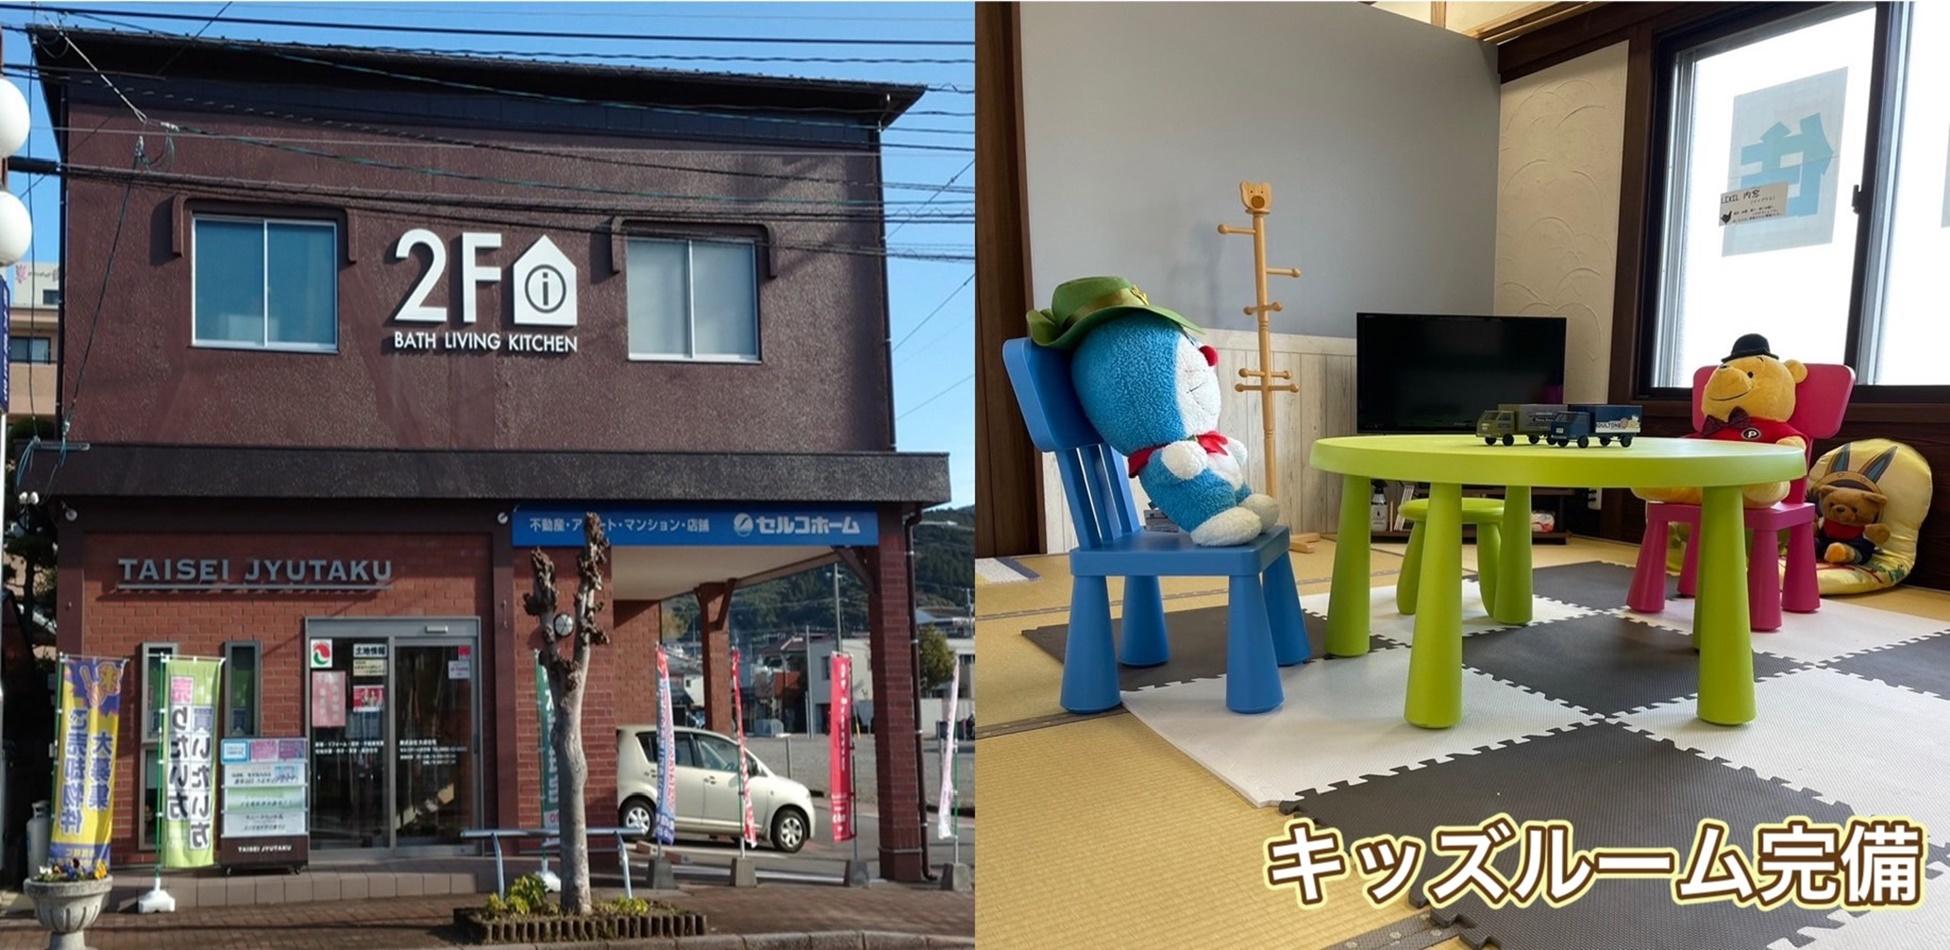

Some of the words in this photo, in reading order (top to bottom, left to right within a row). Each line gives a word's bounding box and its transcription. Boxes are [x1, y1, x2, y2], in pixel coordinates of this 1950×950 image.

[395, 228, 502, 323] 2F
[394, 331, 437, 349] BATH
[445, 332, 500, 350] LIVING
[508, 334, 578, 353] KITCHEN
[756, 516, 861, 534] セルコホーム
[118, 559, 229, 581] TAISEI
[245, 560, 392, 581] JYUTAKU
[238, 845, 260, 853] TAISEI
[261, 845, 292, 853] JYUTAKU
